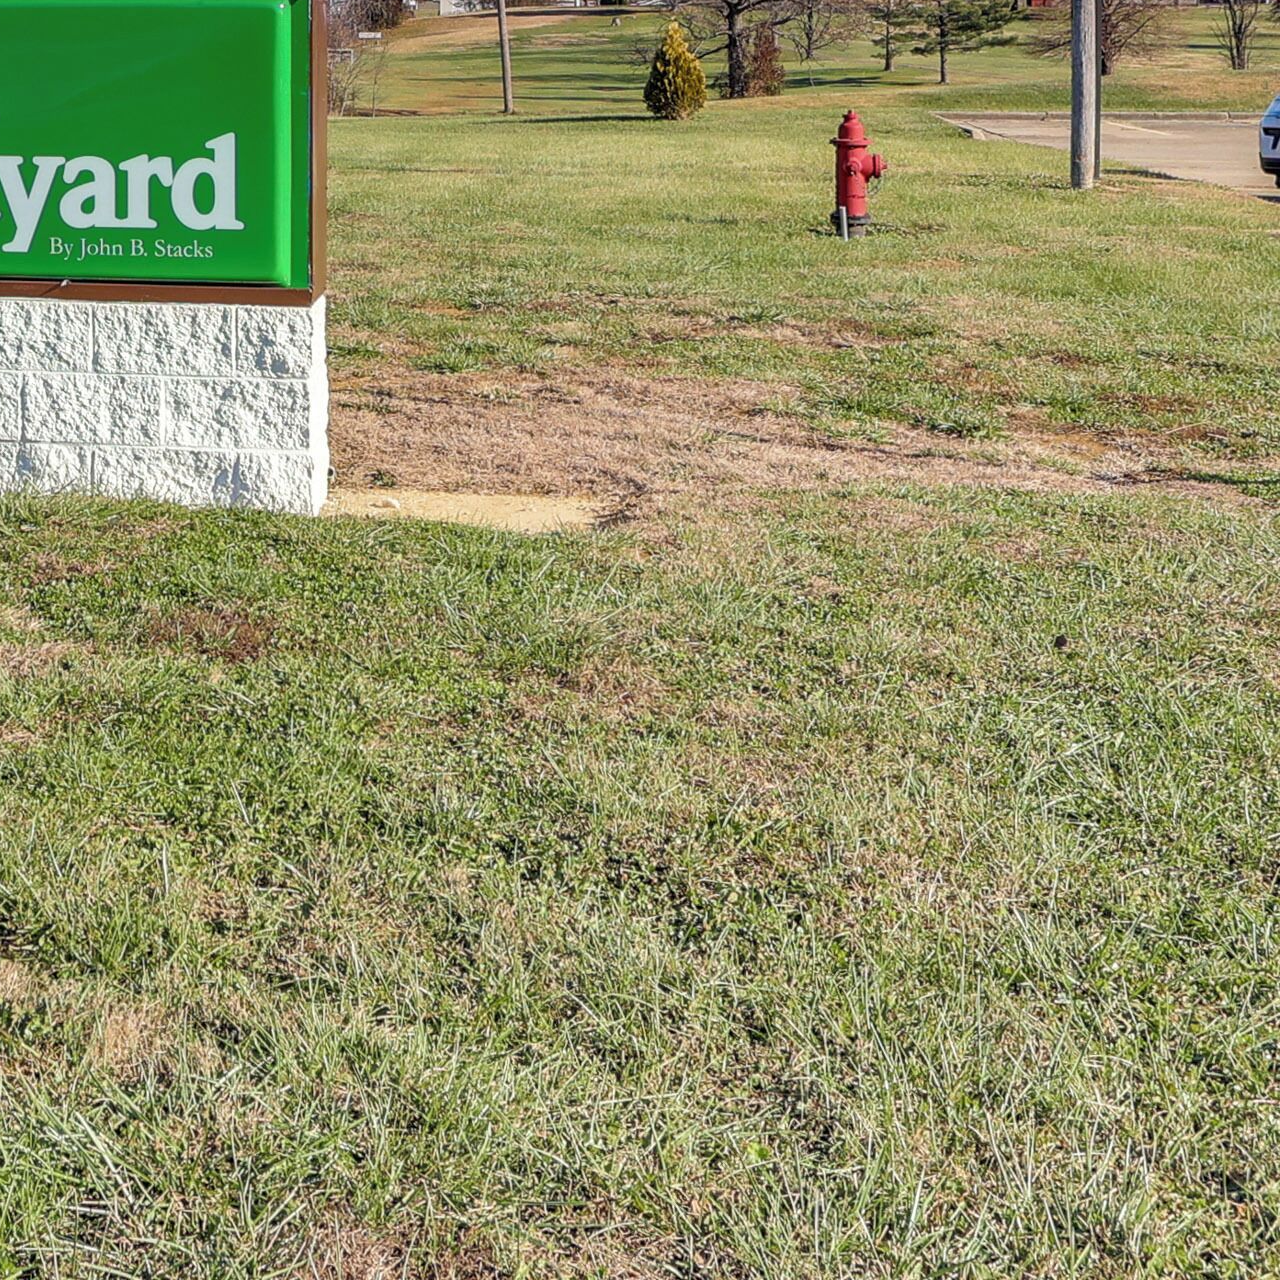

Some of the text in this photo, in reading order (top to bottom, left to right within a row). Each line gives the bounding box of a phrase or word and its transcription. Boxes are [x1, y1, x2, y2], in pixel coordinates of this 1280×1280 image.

[49, 237, 214, 261] By John B. Stacks
